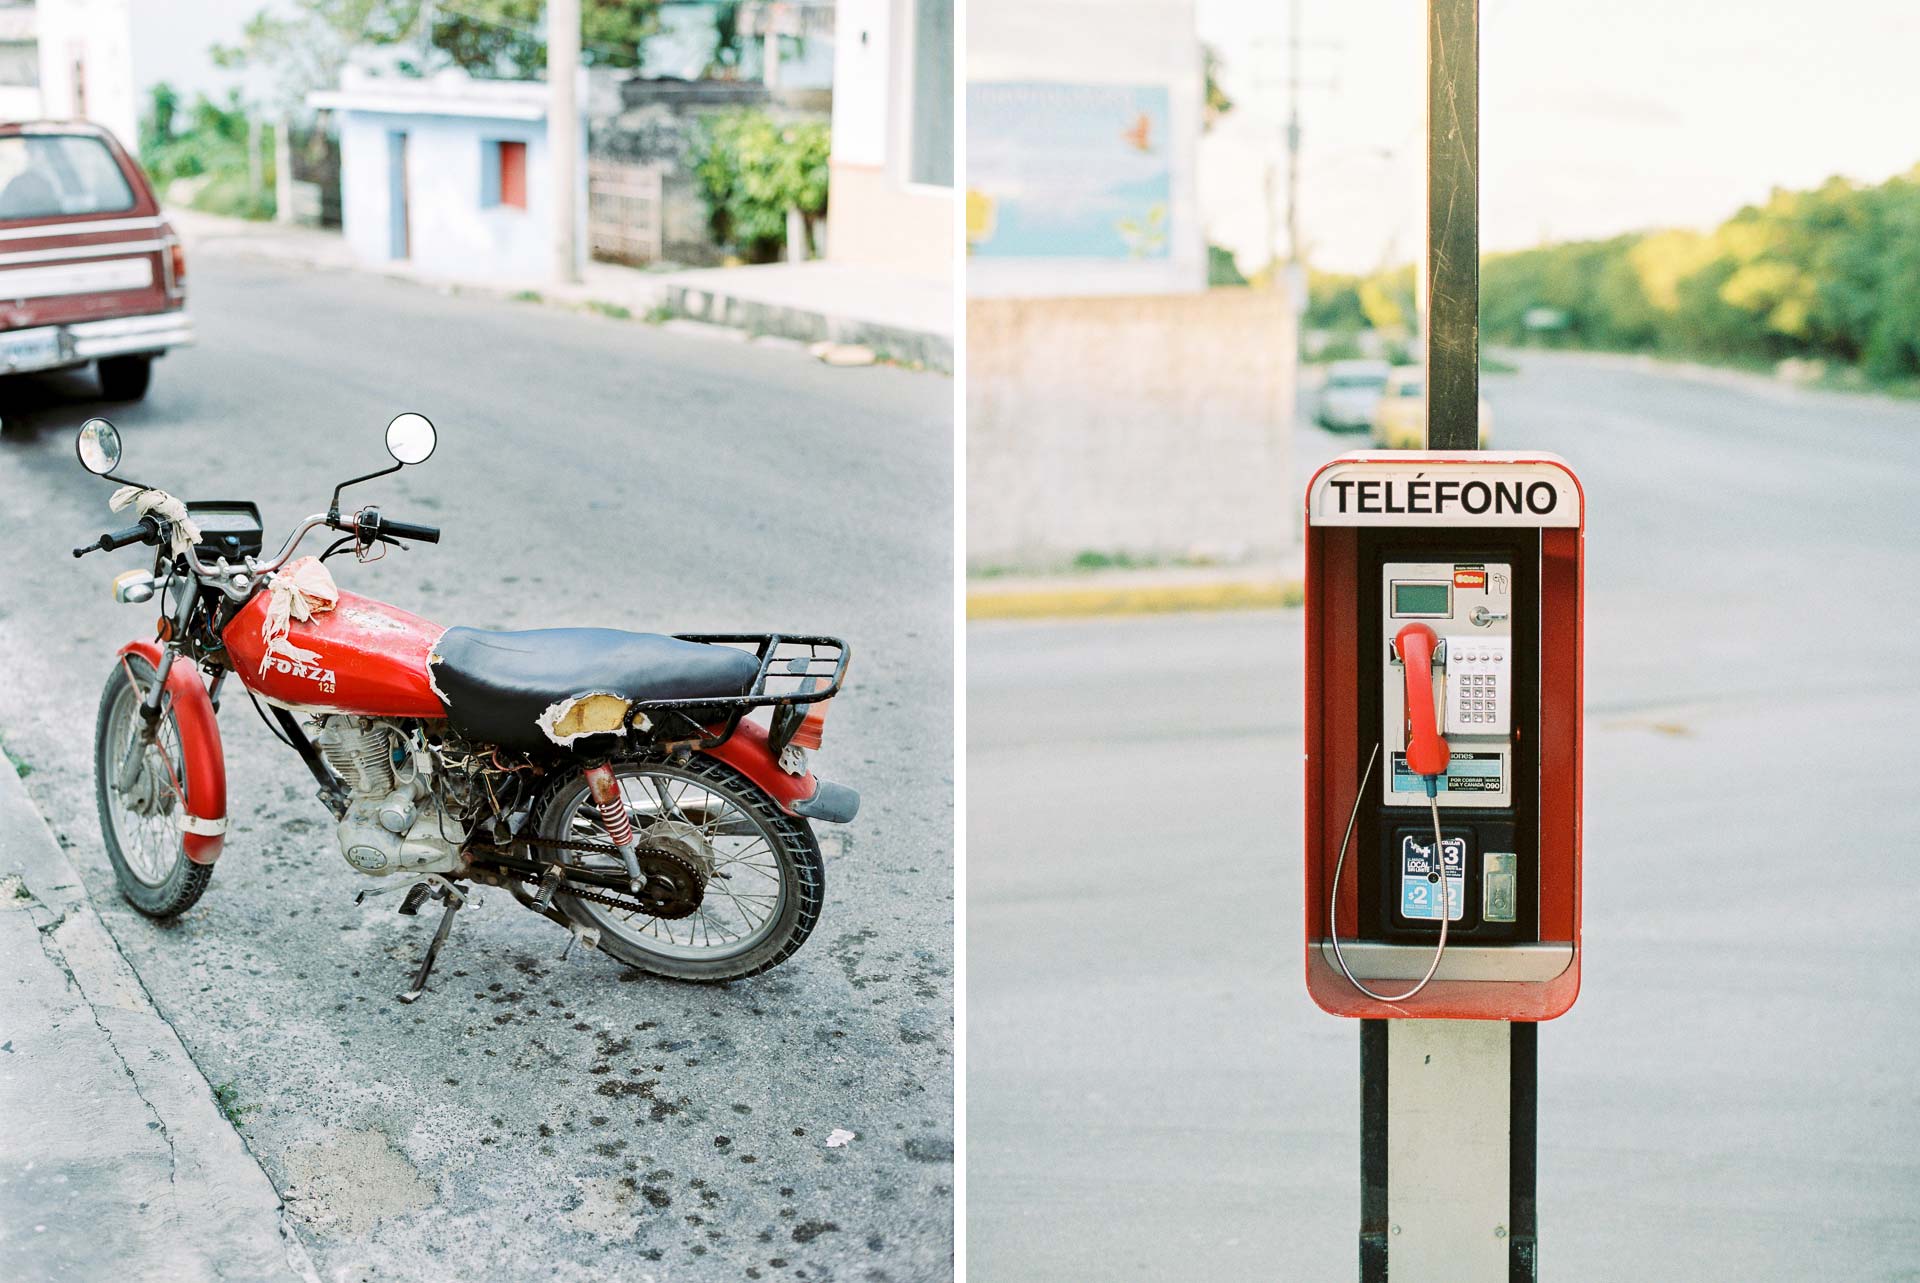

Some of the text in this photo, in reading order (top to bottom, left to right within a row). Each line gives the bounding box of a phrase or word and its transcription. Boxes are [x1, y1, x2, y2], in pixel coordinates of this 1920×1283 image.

[1330, 473, 1557, 514] TELÉFONO
[264, 656, 335, 683] FORZA
[318, 682, 335, 694] 125
